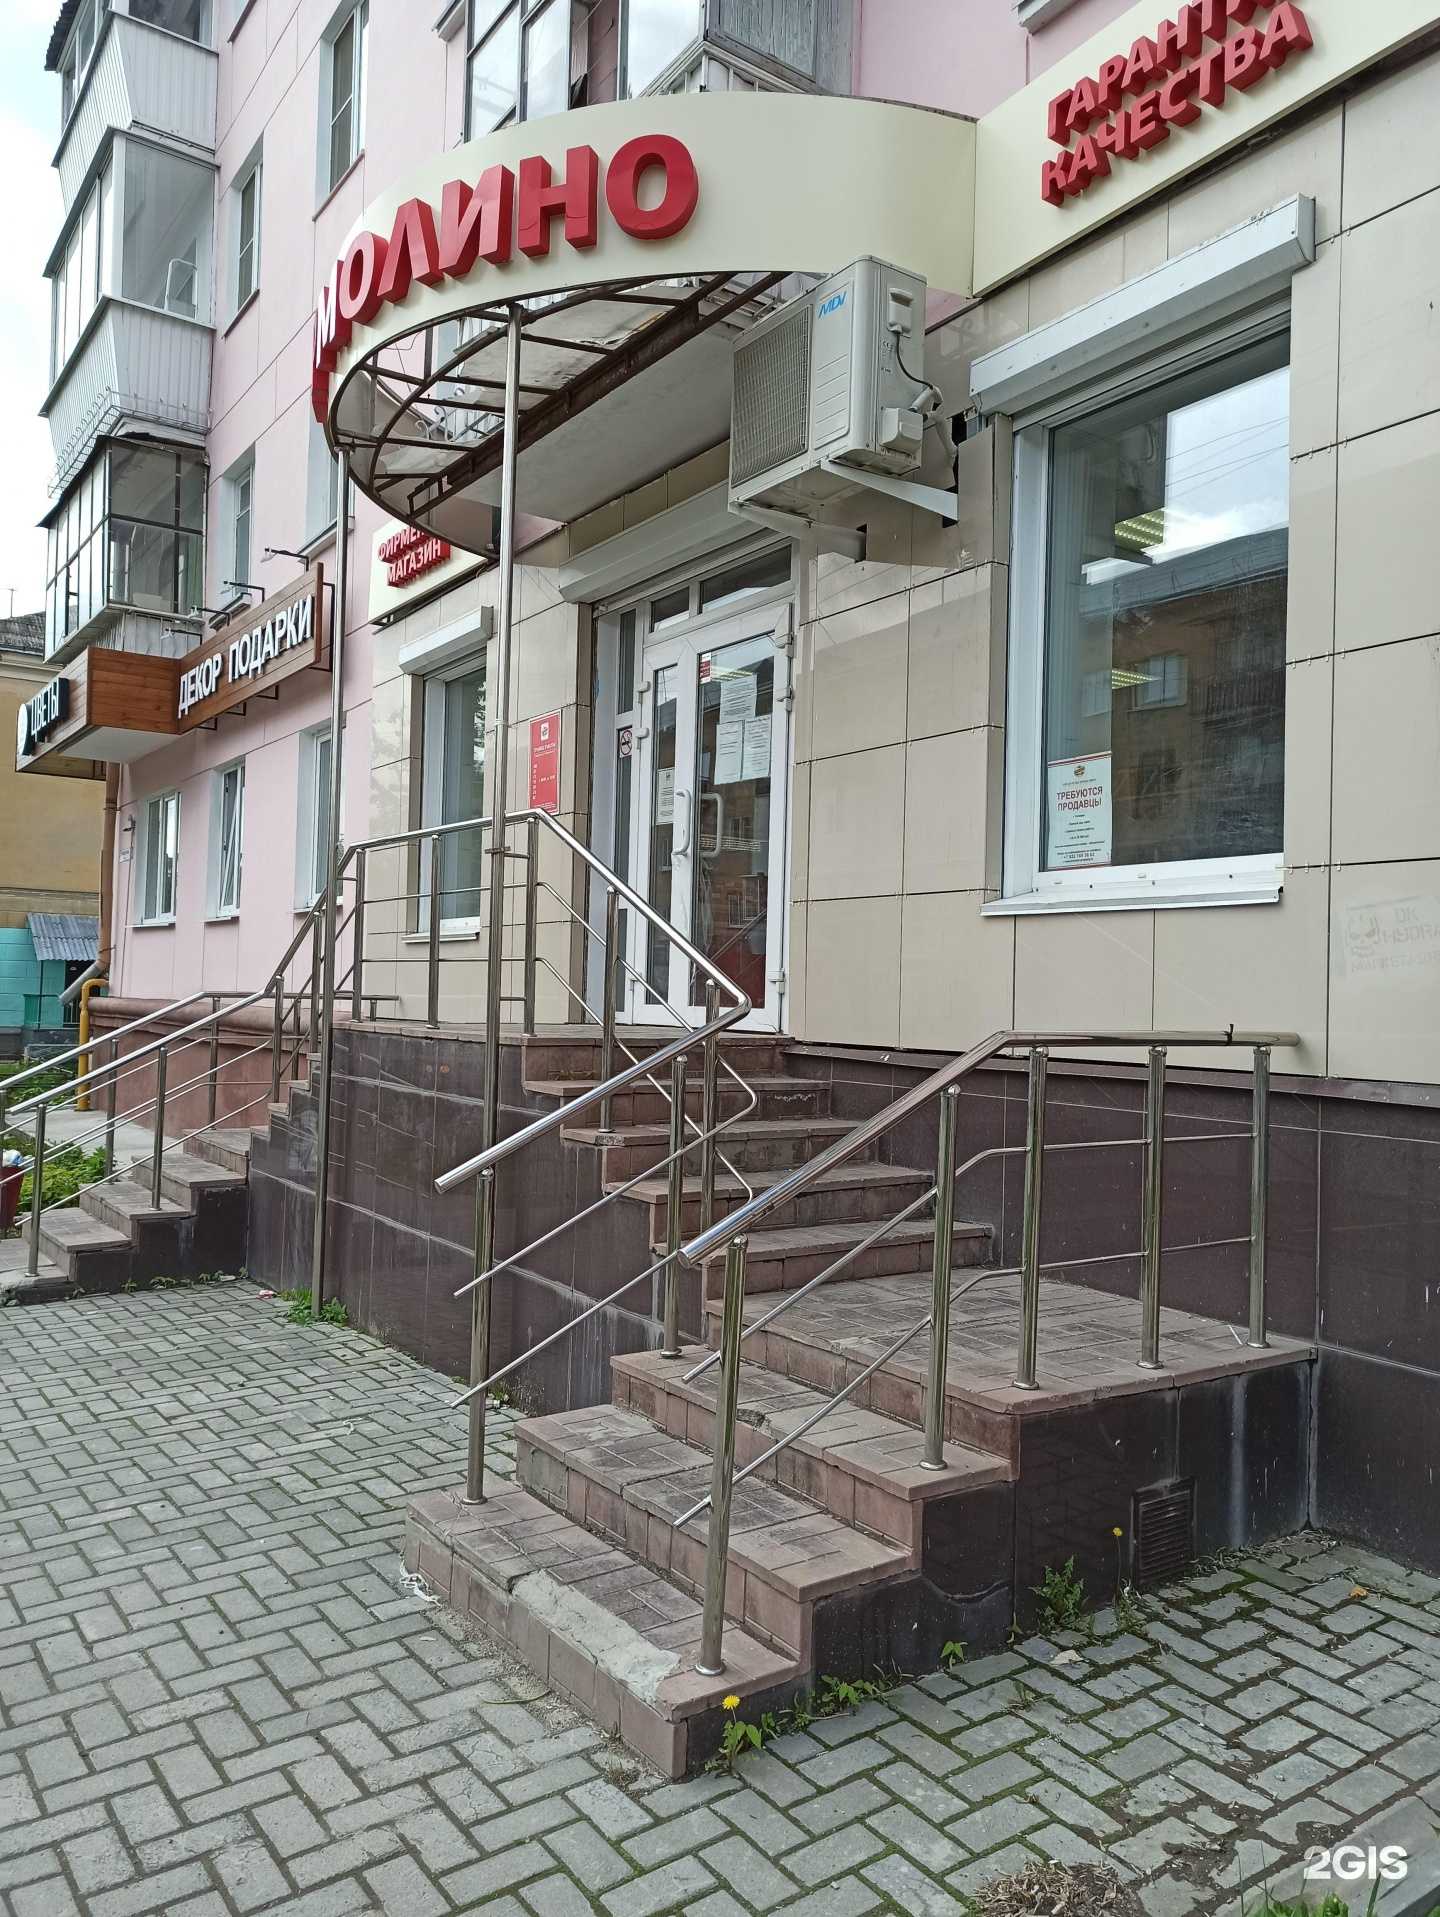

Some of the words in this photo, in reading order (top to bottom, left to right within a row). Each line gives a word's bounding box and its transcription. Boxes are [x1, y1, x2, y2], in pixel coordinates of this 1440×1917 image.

[1041, 2, 1313, 208] КАЧЕСТВА
[312, 134, 699, 423] МОЛИНО
[817, 291, 848, 319] MDV
[379, 526, 430, 564] ФИРМЕ
[388, 538, 450, 588] МАГАЗИН
[178, 652, 223, 719] ДЕКОР
[228, 593, 314, 684] ПОДАРКИ
[30, 675, 61, 743] ЦВЕТЫ
[1056, 786, 1103, 800] ТРЕБУЮТСЯ
[1057, 797, 1102, 811] ПРОДАВЦЫ
